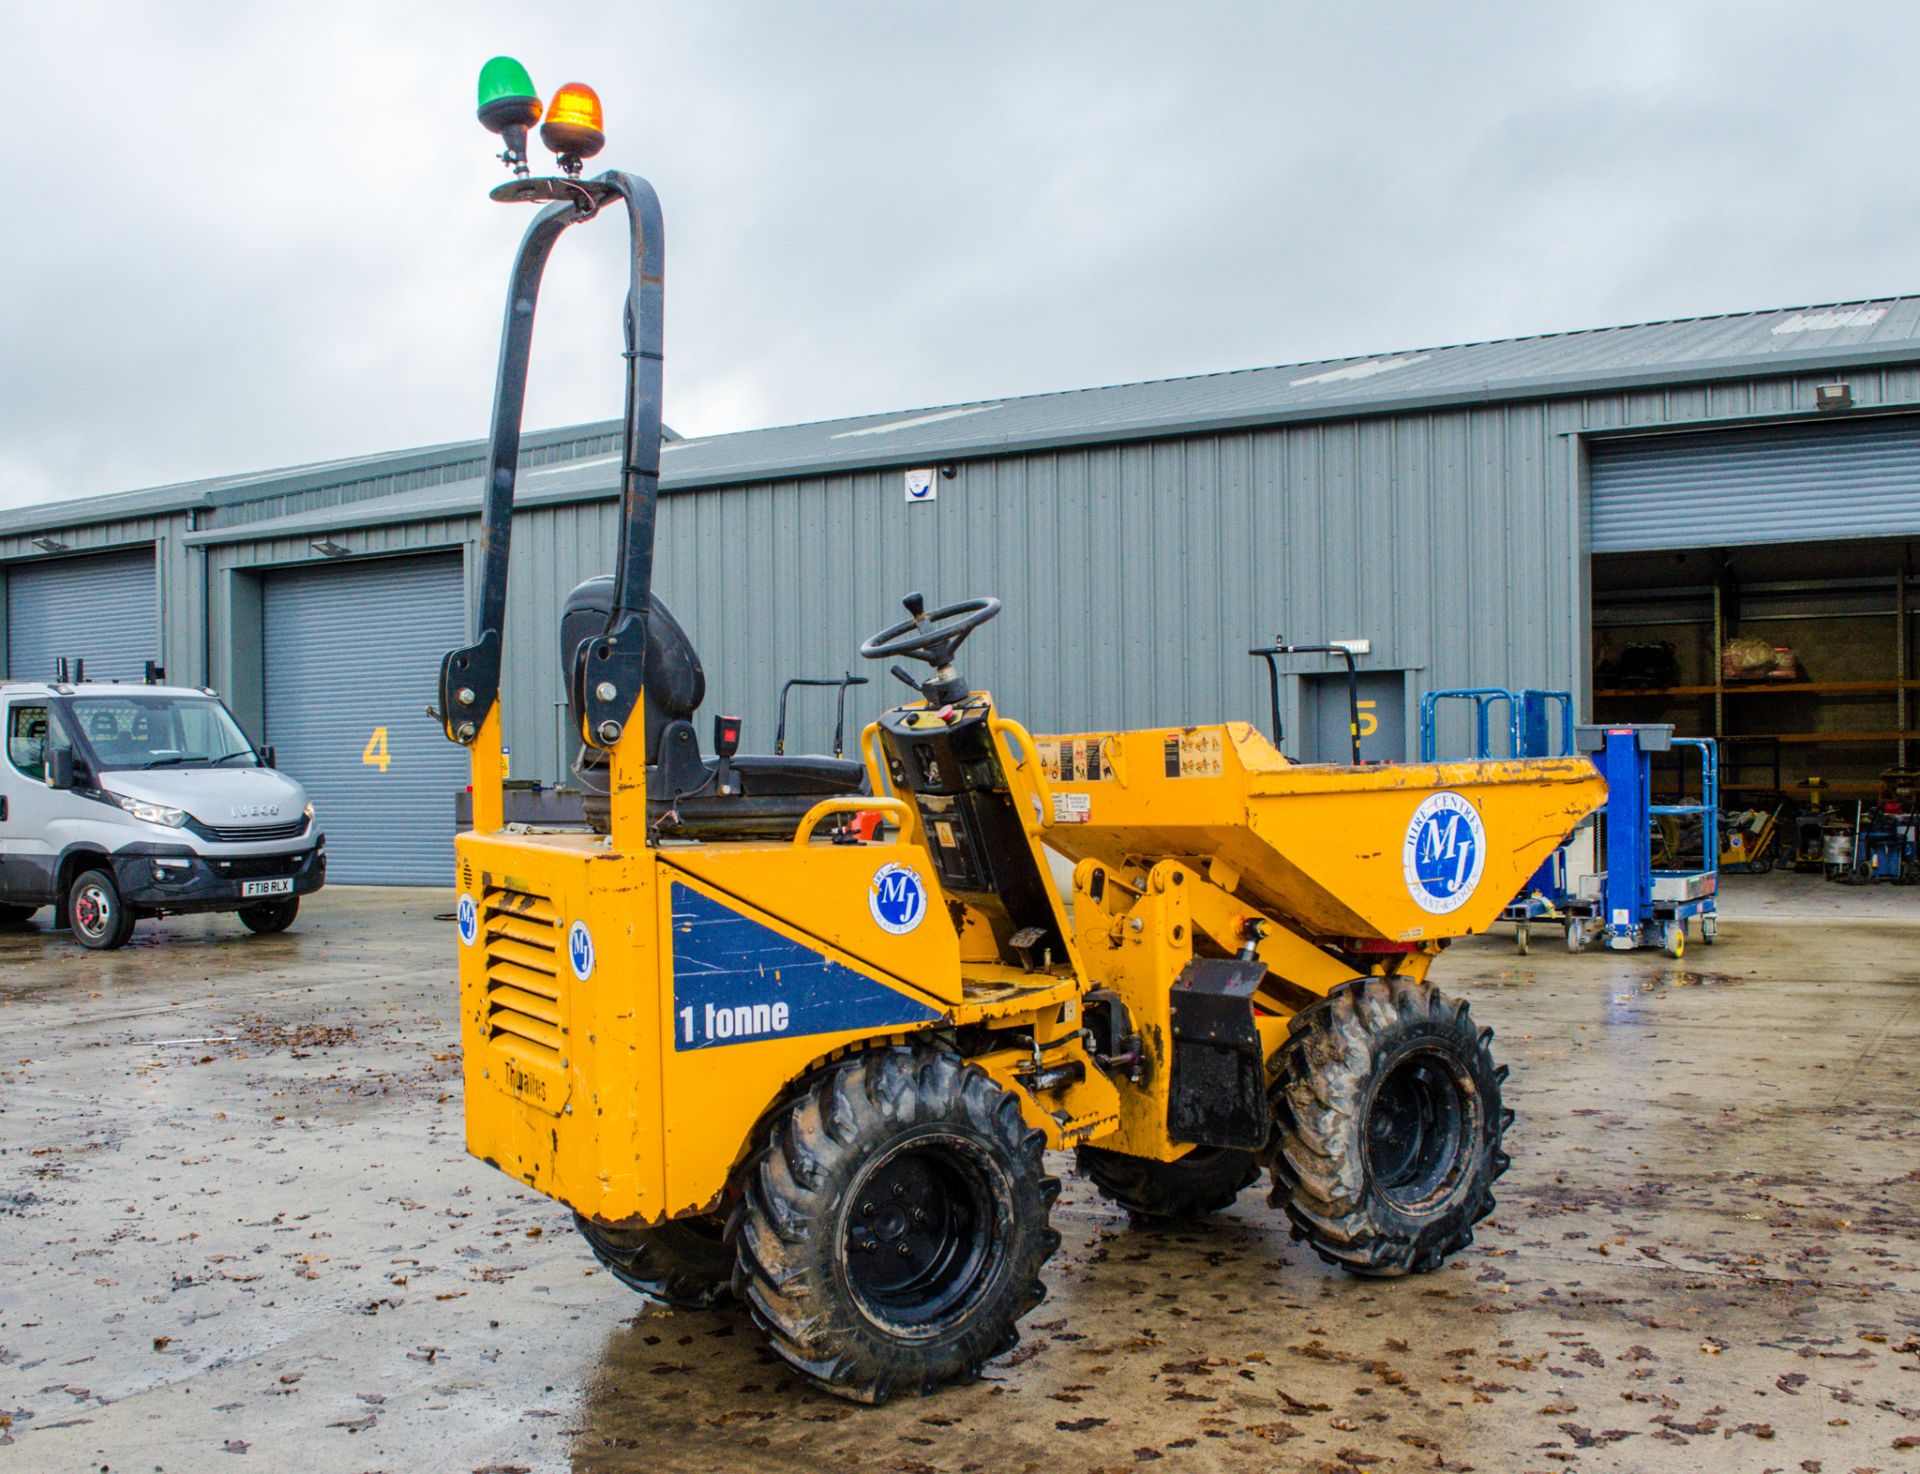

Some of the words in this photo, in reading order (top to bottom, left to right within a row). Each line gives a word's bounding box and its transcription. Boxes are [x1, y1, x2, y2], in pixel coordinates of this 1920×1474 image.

[1356, 700, 1378, 736] 5
[363, 727, 391, 772] 4
[230, 805, 280, 818] IVECO
[1407, 809, 1427, 846] HIRE
[1434, 796, 1480, 834] CENTRES
[1422, 815, 1472, 892] MJ
[248, 882, 269, 894] FT18
[271, 880, 288, 892] RLX
[881, 876, 916, 922] MJ
[461, 903, 473, 938] MJ
[574, 932, 588, 971] MJ
[680, 1006, 693, 1042] 1
[706, 1002, 789, 1039] tonne
